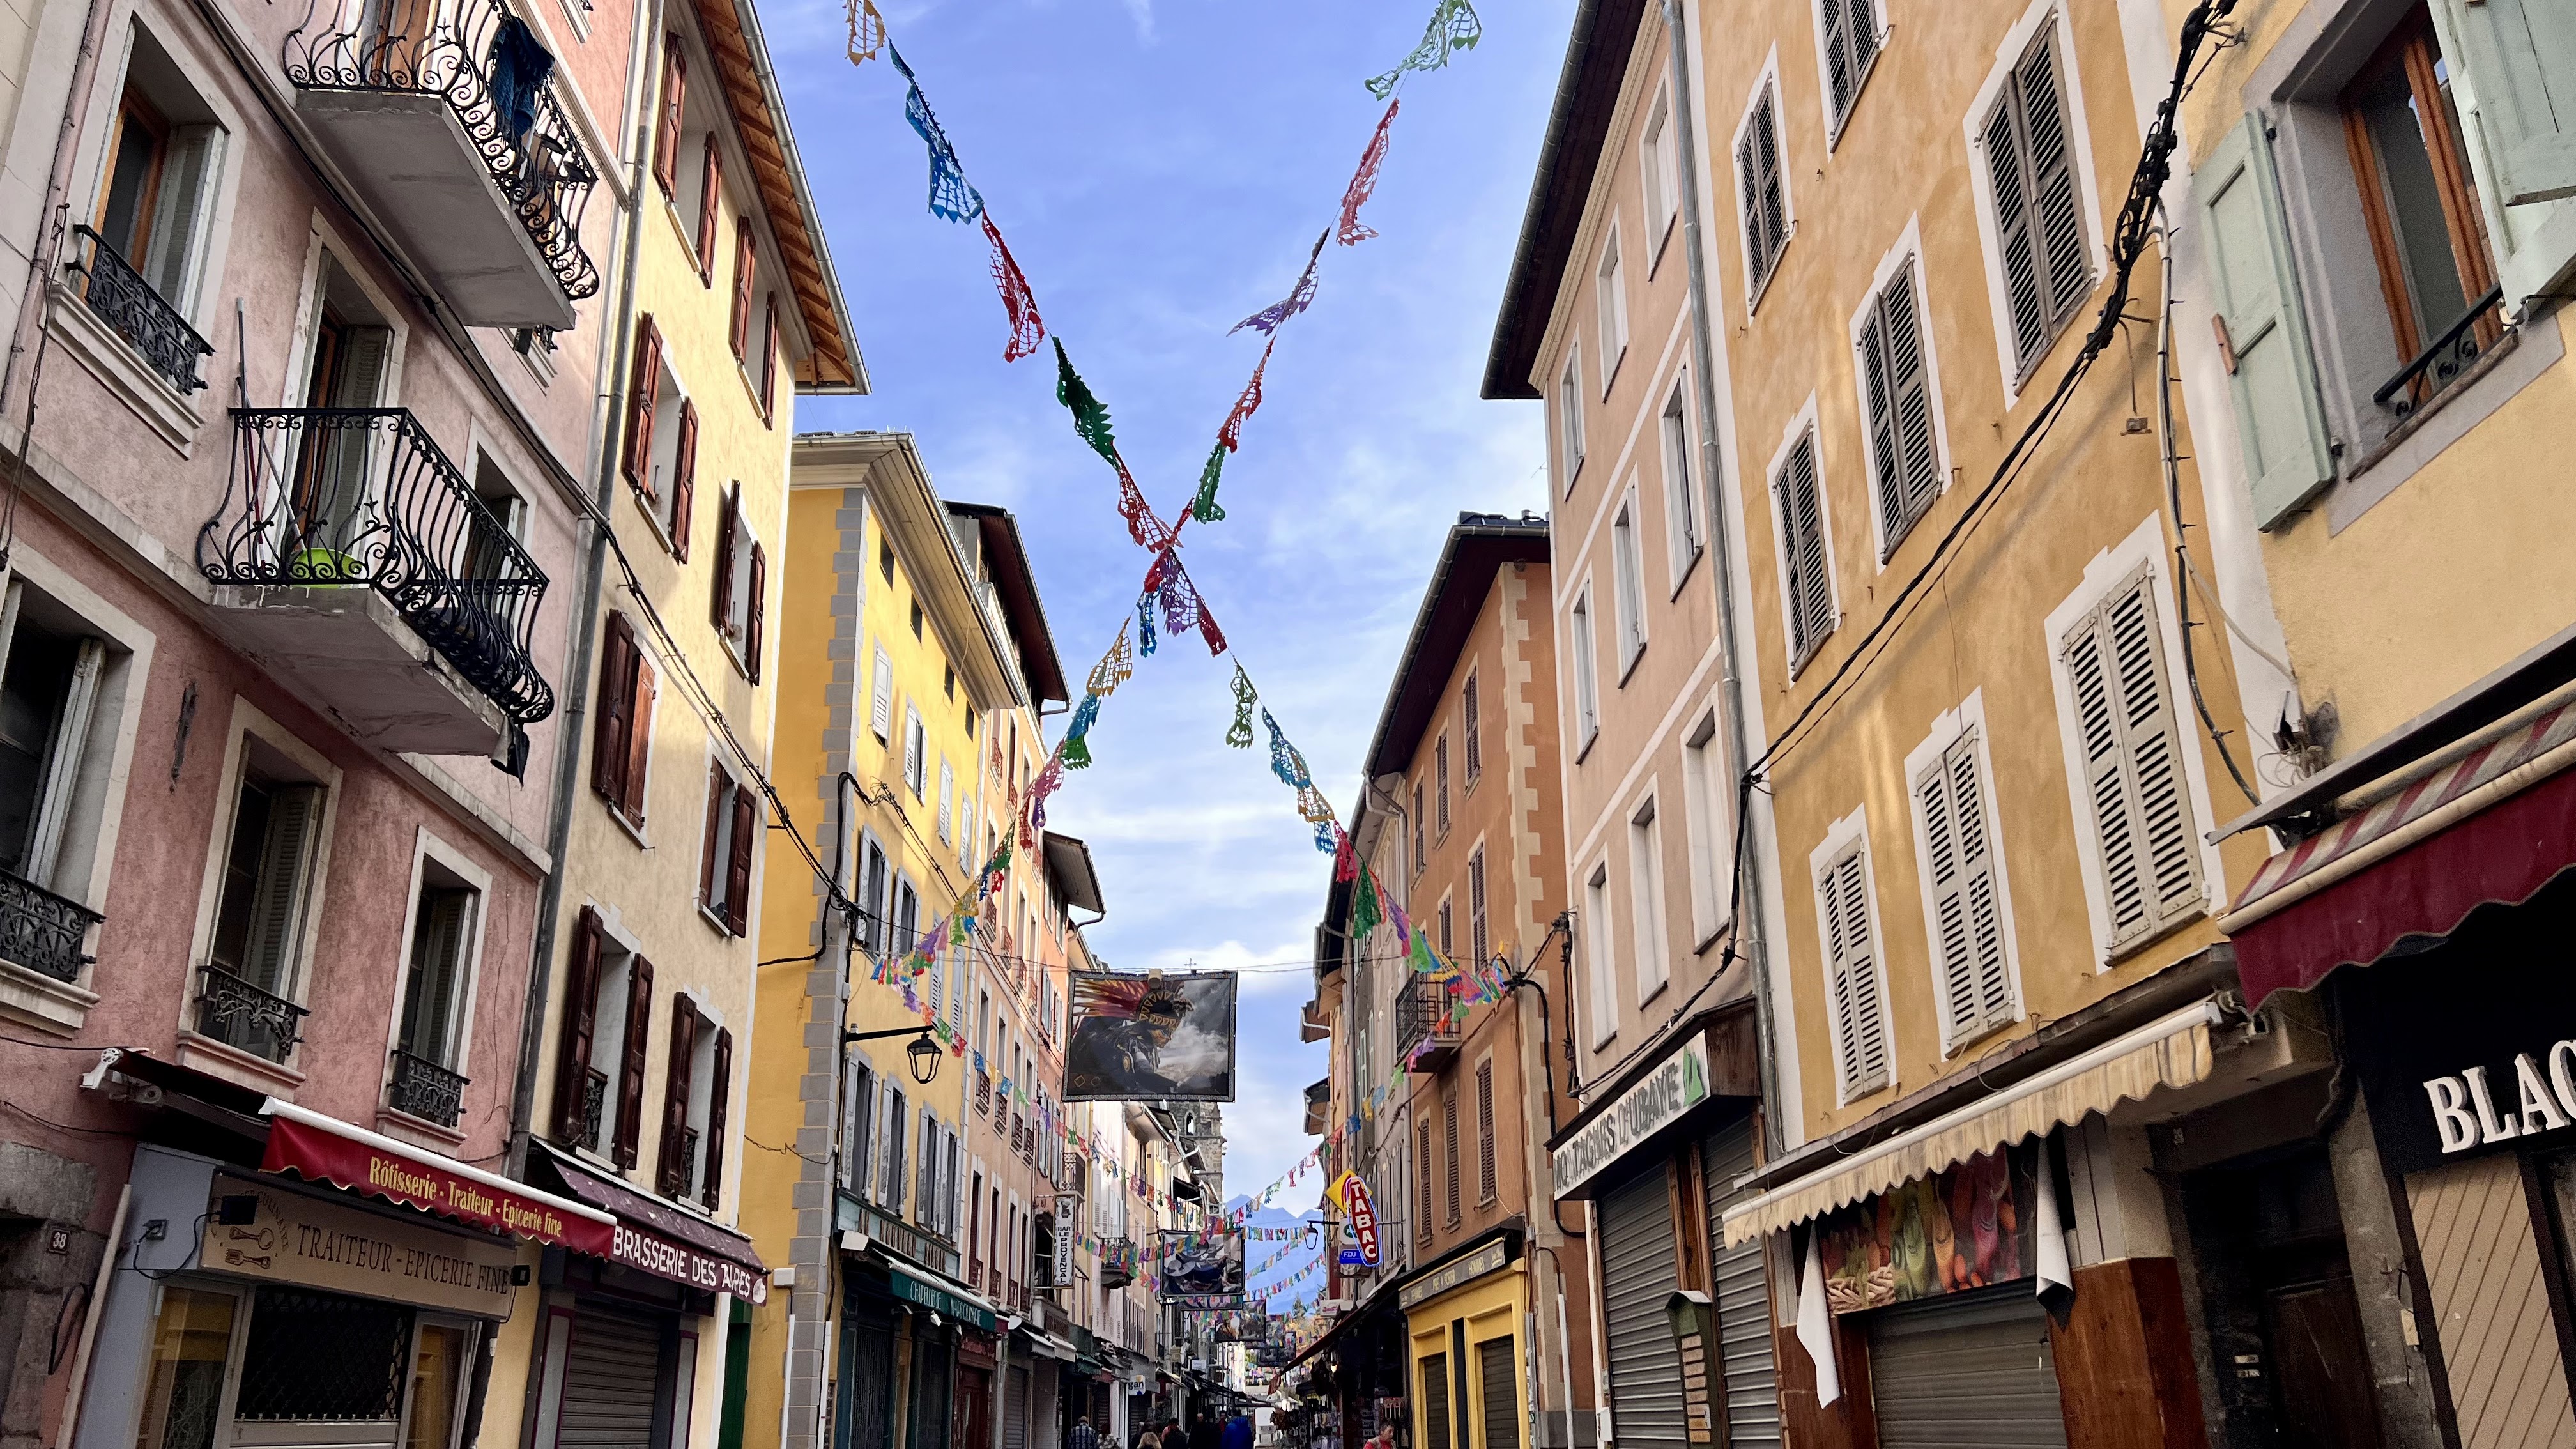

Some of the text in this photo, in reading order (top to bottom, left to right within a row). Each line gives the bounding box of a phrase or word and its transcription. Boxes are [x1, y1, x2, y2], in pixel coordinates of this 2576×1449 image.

[1554, 1062, 1680, 1192] MONTAGNES D'UBAYE
[369, 1156, 437, 1200] Rôtisserie
[448, 1181, 494, 1216] Traiteur
[502, 1199, 542, 1232] Epicerie
[544, 1211, 562, 1237] fine
[1351, 1183, 1376, 1259] TABAC
[52, 1232, 67, 1250] 38
[297, 1222, 392, 1273] TRAITEUR
[404, 1248, 474, 1287] EPICERIE
[477, 1264, 509, 1294] FINE
[613, 1225, 751, 1298] BRASSERIE DES ALPES
[1128, 1380, 1144, 1390] gan
